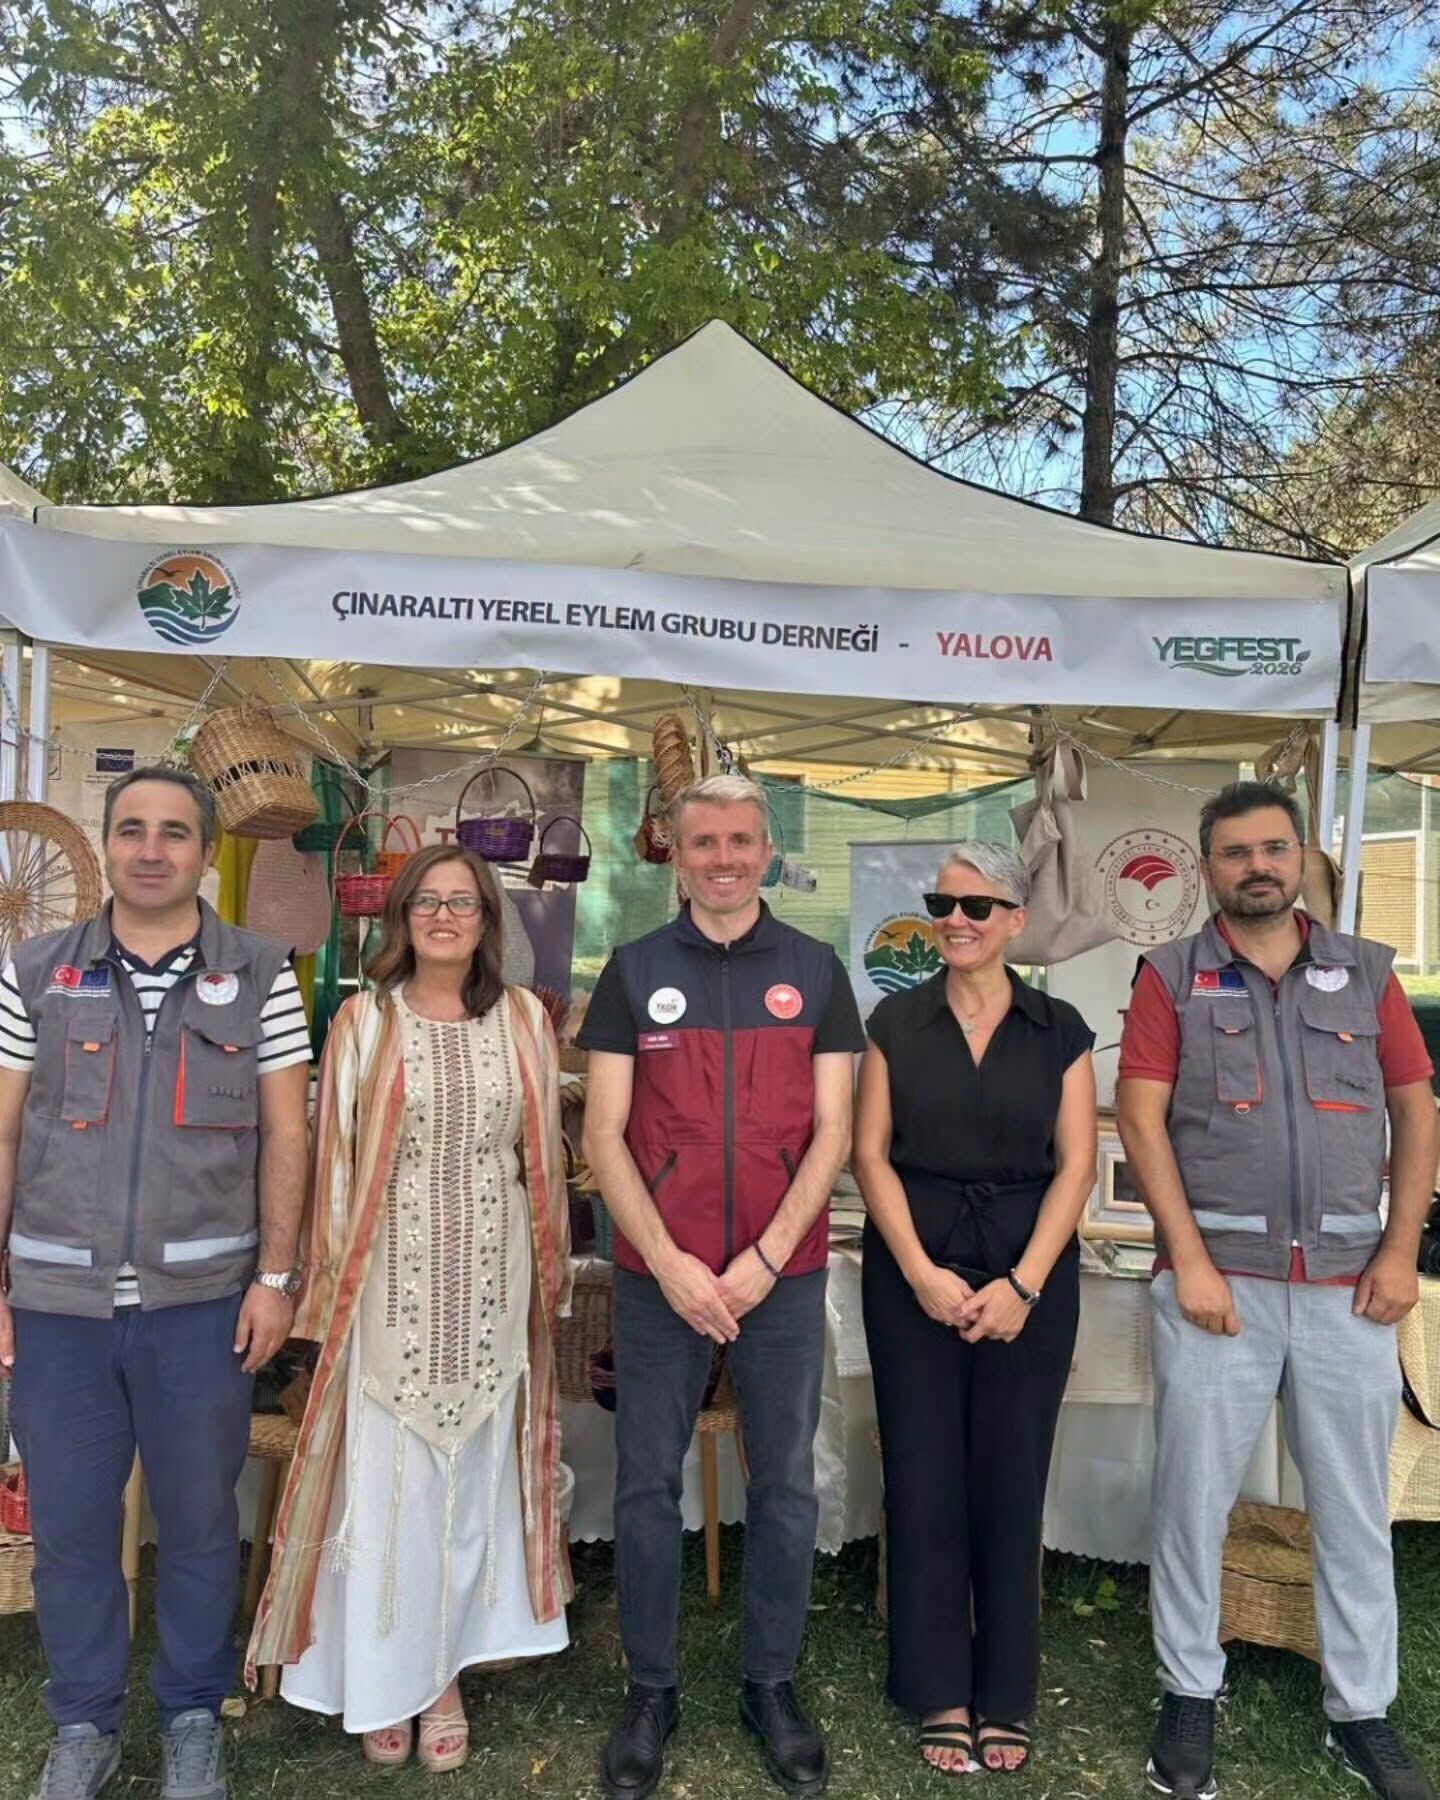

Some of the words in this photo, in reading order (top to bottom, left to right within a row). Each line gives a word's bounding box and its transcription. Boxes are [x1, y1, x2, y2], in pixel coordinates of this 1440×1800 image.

[331, 591, 474, 622] ÇINARALTI
[478, 598, 561, 625] YEREL
[565, 603, 655, 633] EYLEM
[660, 613, 757, 642] GRUBU
[761, 622, 879, 653] DERNEĞİ
[936, 632, 1054, 662] YALOVA
[1152, 636, 1302, 662] YEGFEST
[1249, 662, 1305, 677] 2026
